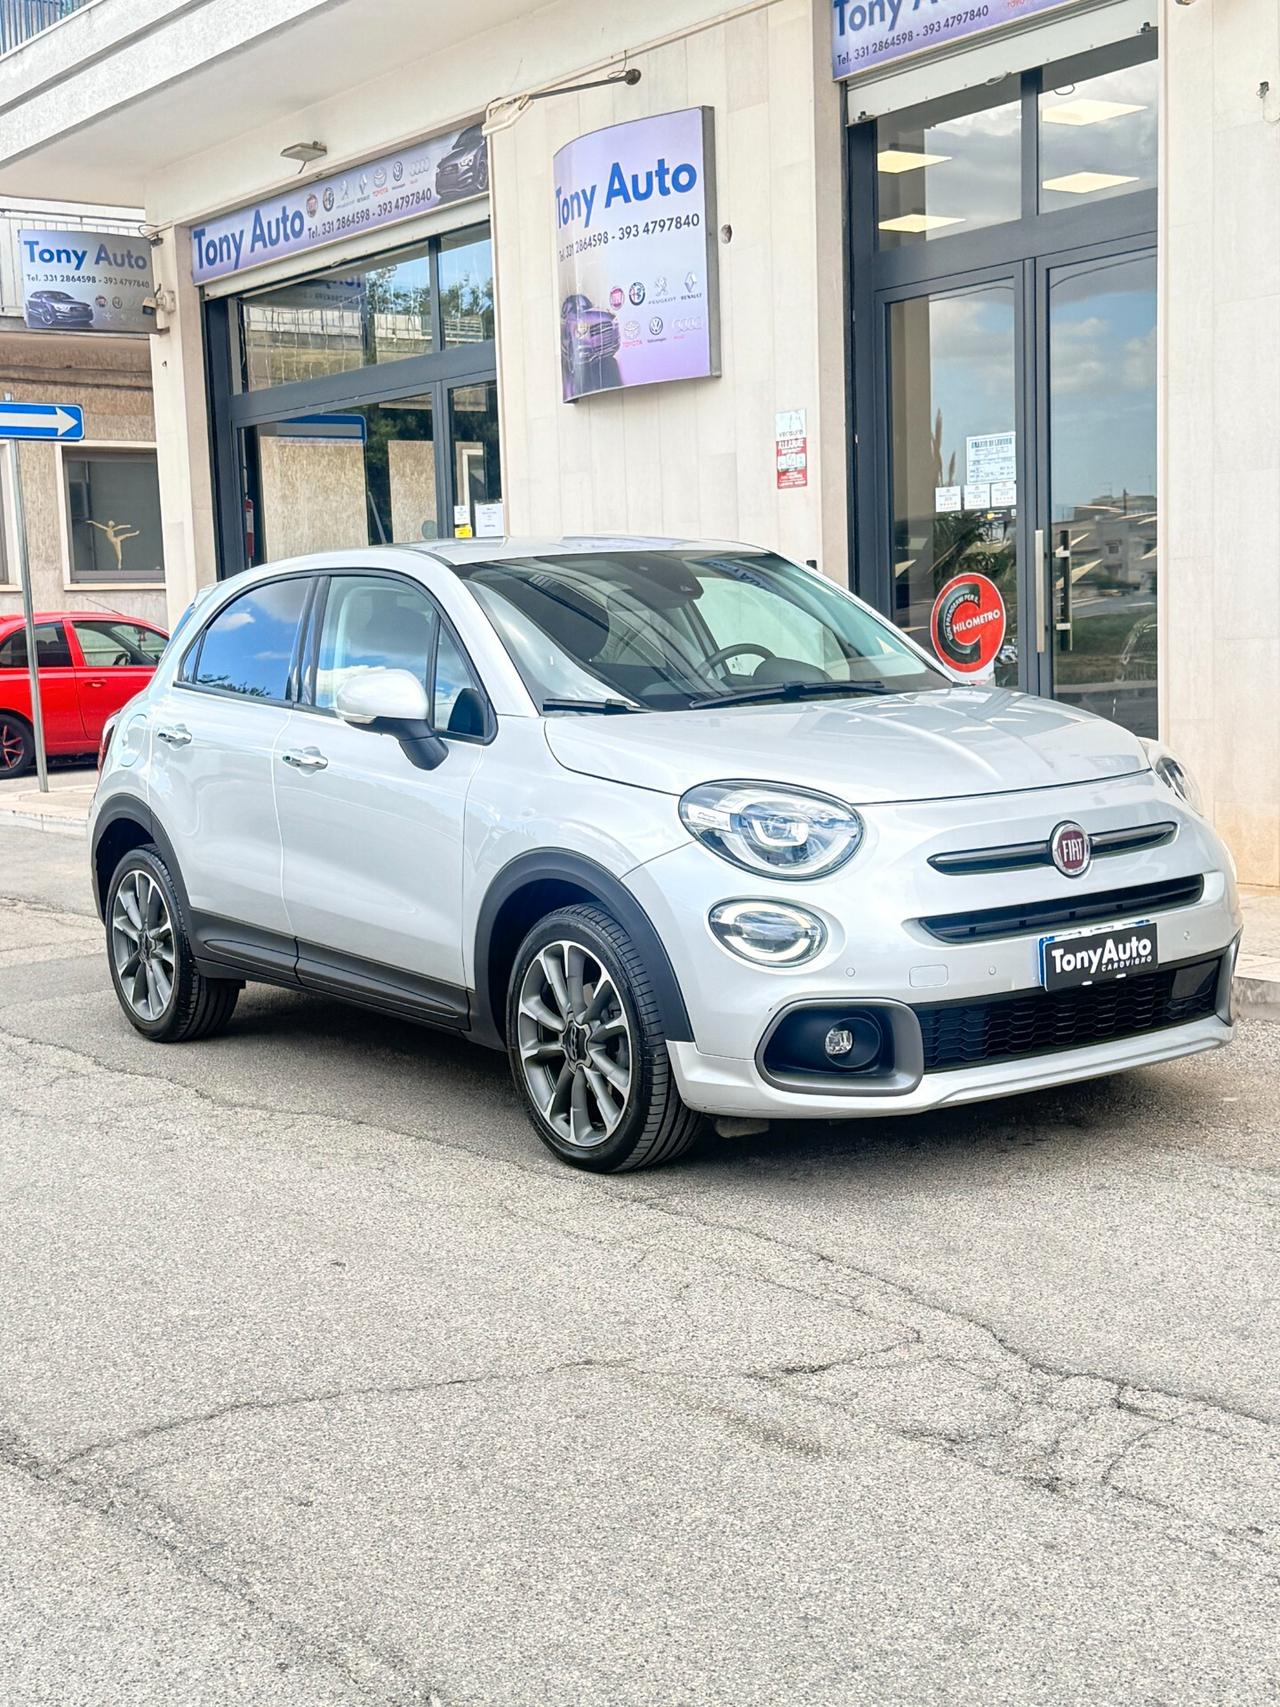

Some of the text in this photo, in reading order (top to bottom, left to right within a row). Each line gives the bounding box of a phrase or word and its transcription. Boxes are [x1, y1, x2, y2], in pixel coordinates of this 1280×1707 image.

[834, 0, 902, 36] Tony
[837, 54, 852, 66] Tel.
[854, 46, 869, 60] 331
[872, 31, 913, 55] 2864598
[922, 21, 941, 37] 393
[943, 5, 989, 28] 4797840
[555, 158, 697, 229] Tony Auto
[307, 227, 319, 239] Tel.
[322, 221, 334, 235] 331
[337, 209, 370, 230] 2864598
[377, 201, 393, 217] 393
[395, 188, 432, 210] 4797840
[193, 205, 304, 270] Tony Auto
[575, 231, 609, 254] 2864598
[618, 224, 640, 241] 393
[642, 213, 700, 235] 4797840
[24, 241, 148, 271] Tony Auto
[27, 274, 41, 282] Tel.
[43, 274, 58, 282] 331
[60, 274, 97, 283] 2864598
[103, 276, 118, 285] 393
[1062, 838, 1083, 863] FIAT
[1101, 955, 1152, 971] CAROVIGNO
